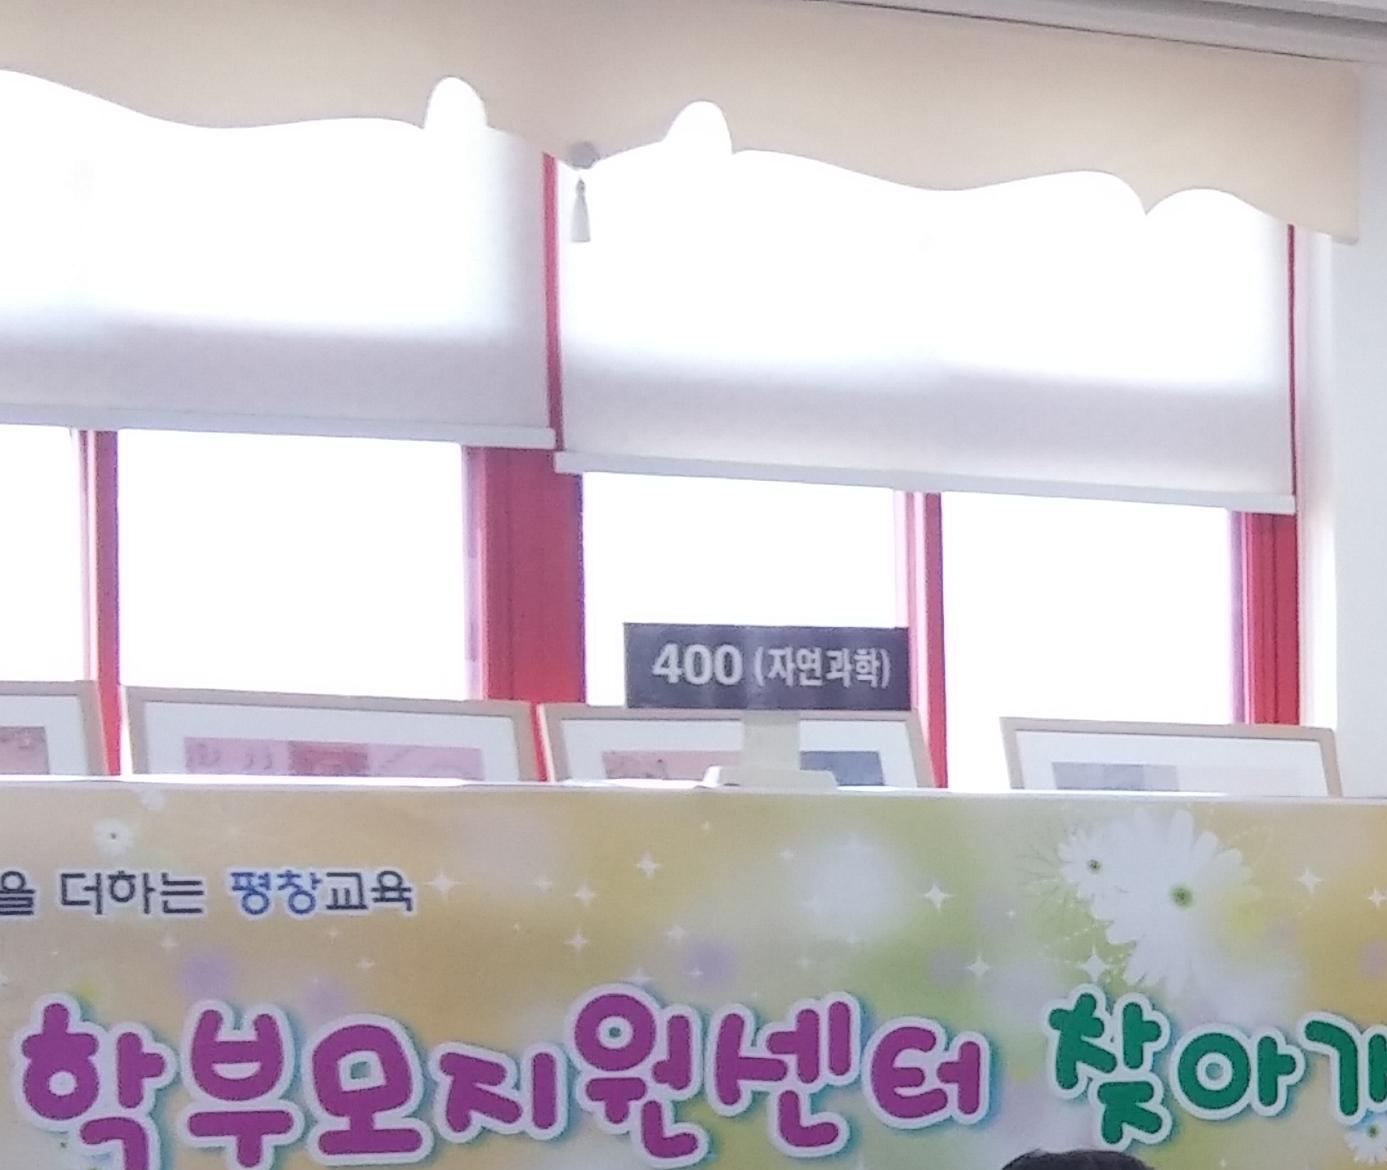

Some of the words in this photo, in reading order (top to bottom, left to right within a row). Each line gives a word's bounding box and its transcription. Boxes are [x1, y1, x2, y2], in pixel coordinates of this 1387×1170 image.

[652, 643, 743, 685] 400
[754, 646, 890, 688] (자연과학)
[60, 870, 205, 916] 더하는
[230, 869, 414, 916] 평창교육
